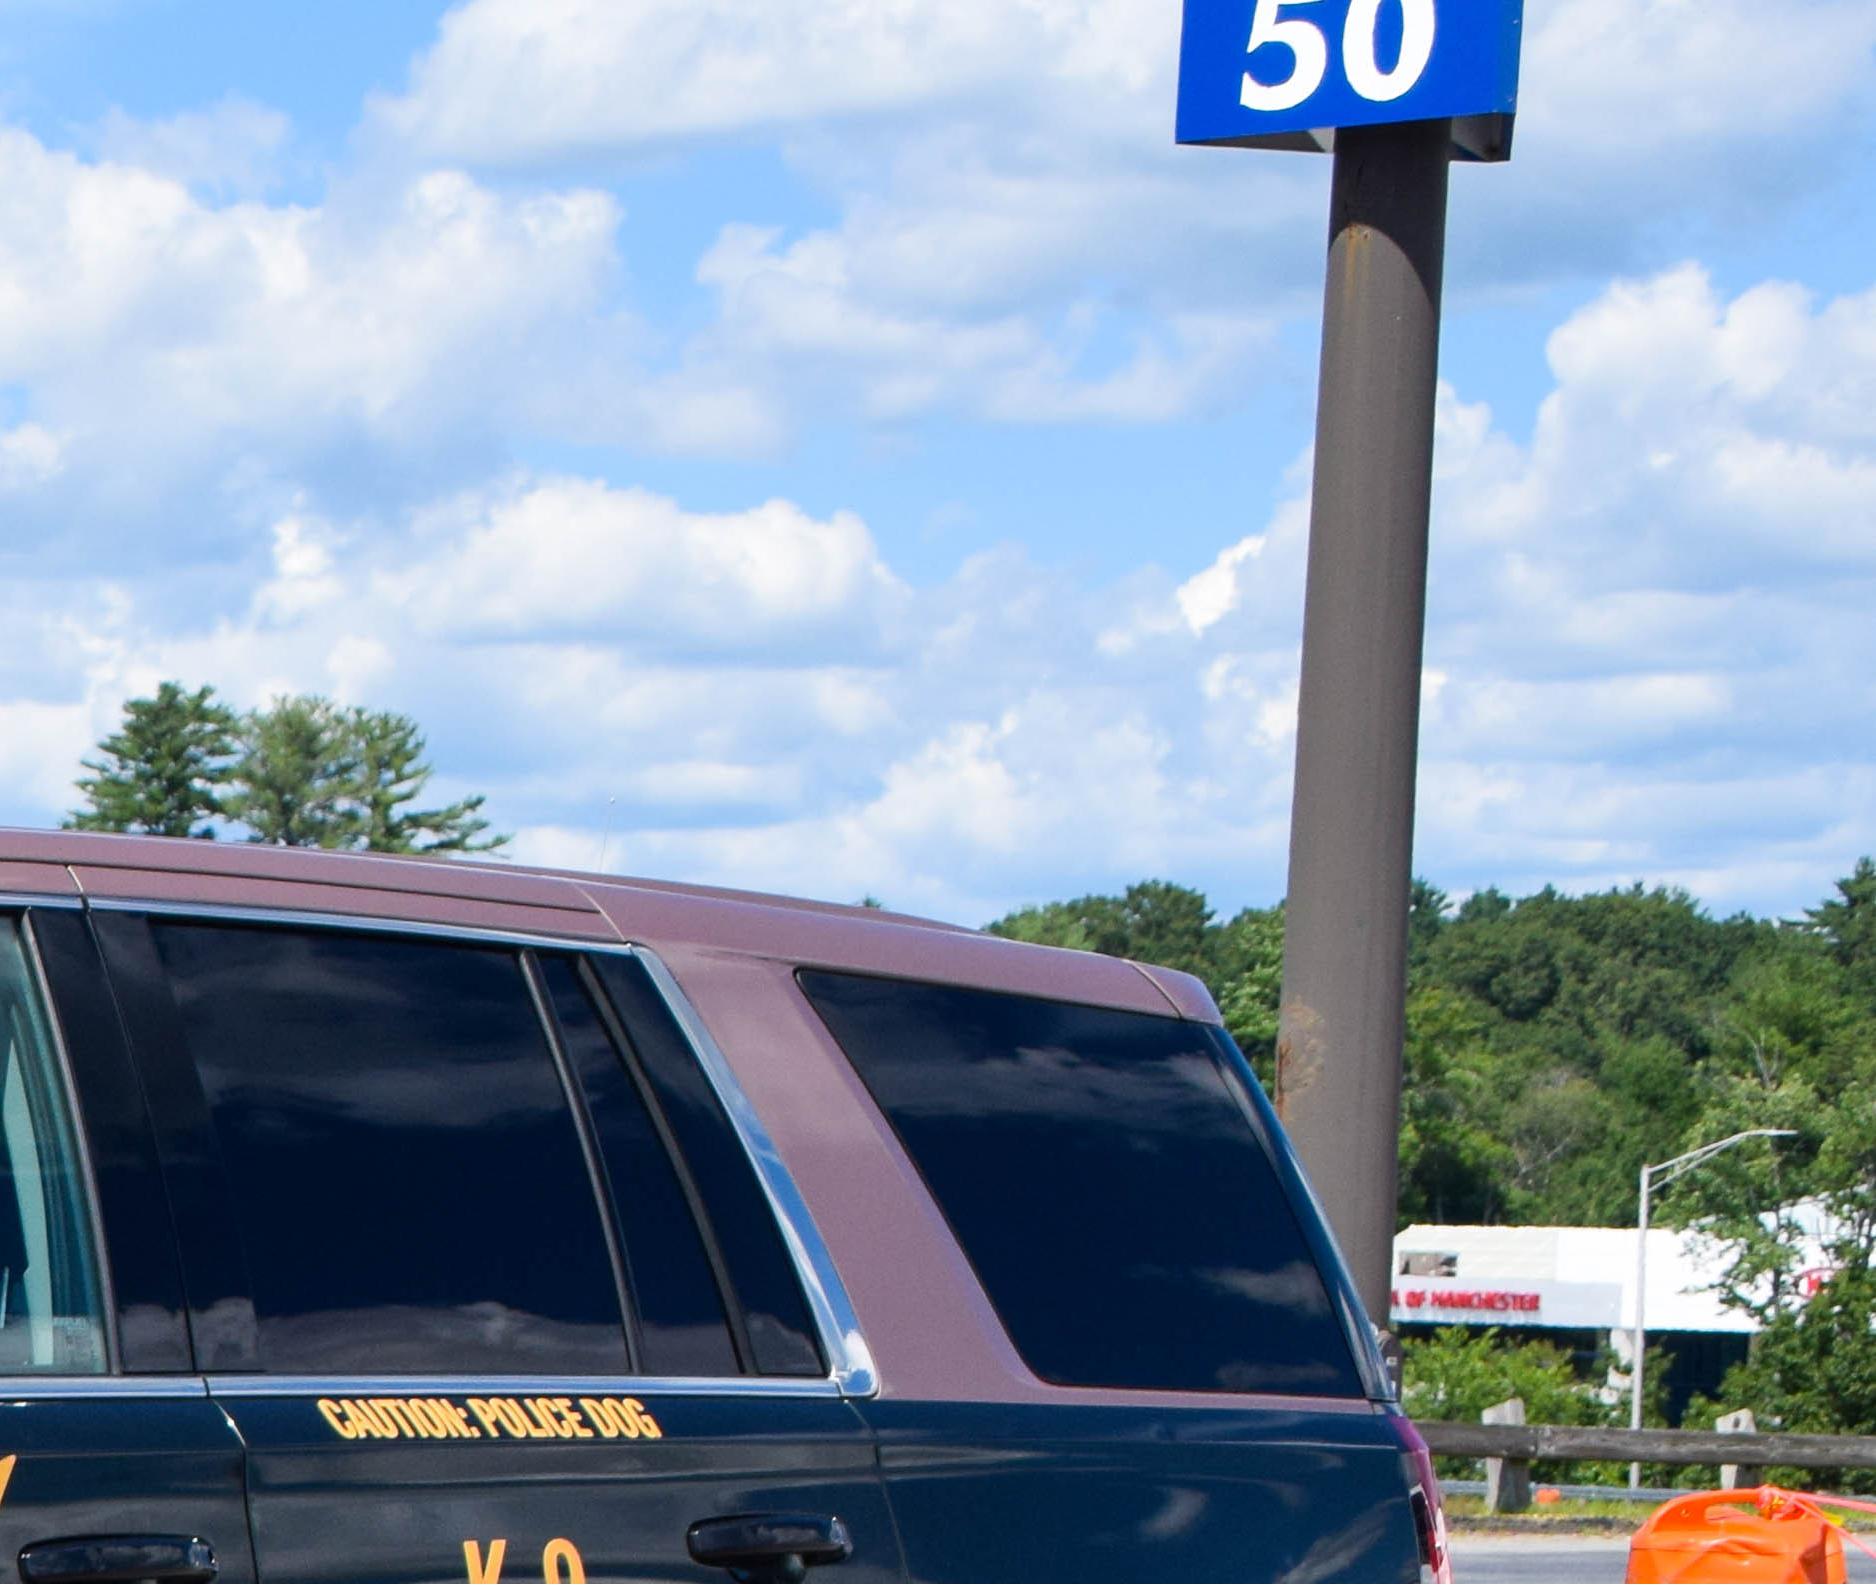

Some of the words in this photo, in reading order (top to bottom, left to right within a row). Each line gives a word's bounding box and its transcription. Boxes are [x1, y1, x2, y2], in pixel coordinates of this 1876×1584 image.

[1239, 0, 1436, 112] 50
[1431, 1290, 1540, 1311] MANCHESTER
[466, 1397, 594, 1439] POLICE
[579, 1397, 663, 1439] DOG
